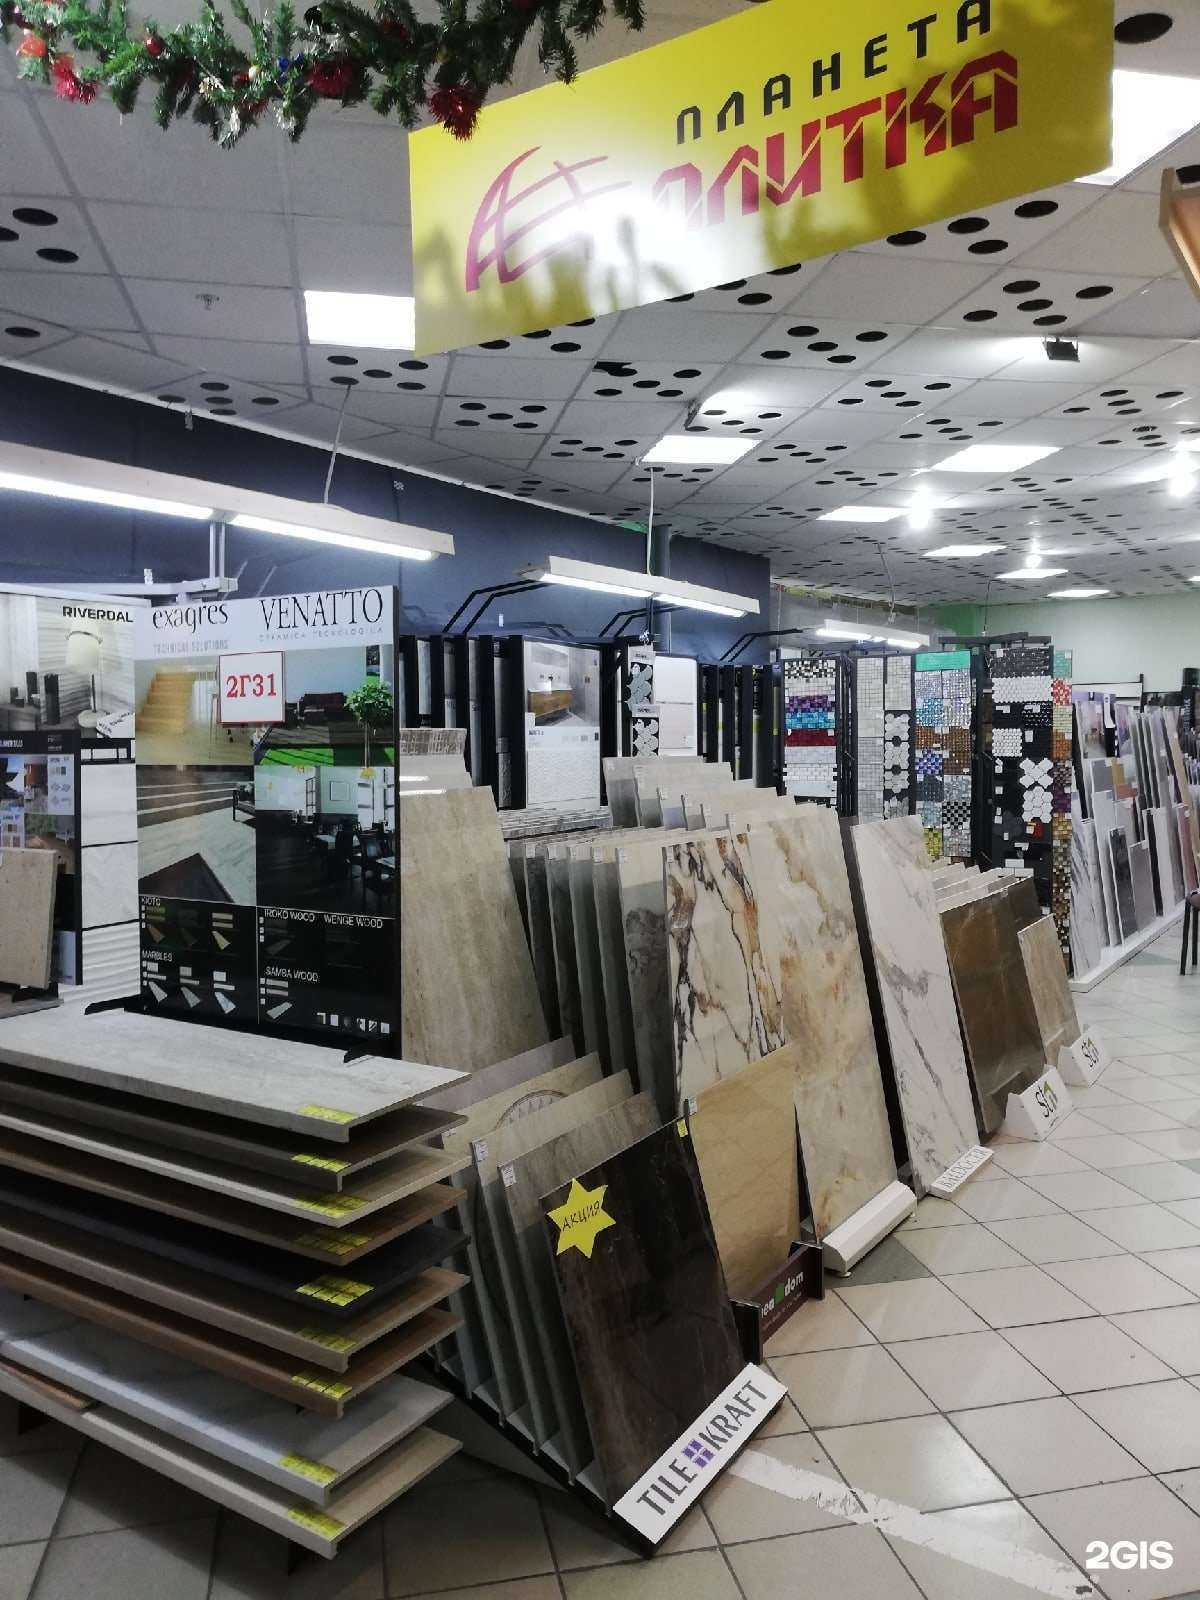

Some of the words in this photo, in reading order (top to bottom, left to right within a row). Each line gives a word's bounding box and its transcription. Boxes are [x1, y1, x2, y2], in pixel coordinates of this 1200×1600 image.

[676, 0, 991, 145] ПЛАНЕТА
[62, 606, 134, 623] RIVERDAL
[152, 603, 229, 634] exagres
[258, 588, 384, 631] VENATTO
[226, 673, 277, 698] 2Г31
[323, 914, 354, 926] WENGE
[356, 917, 383, 929] WOOD
[265, 966, 293, 979] SAMBA
[293, 969, 319, 983] WOOD
[561, 1199, 602, 1232] АКЦИЯ
[784, 1271, 804, 1297] dom
[636, 1458, 699, 1516] TILE
[698, 1380, 768, 1451] KRAFT
